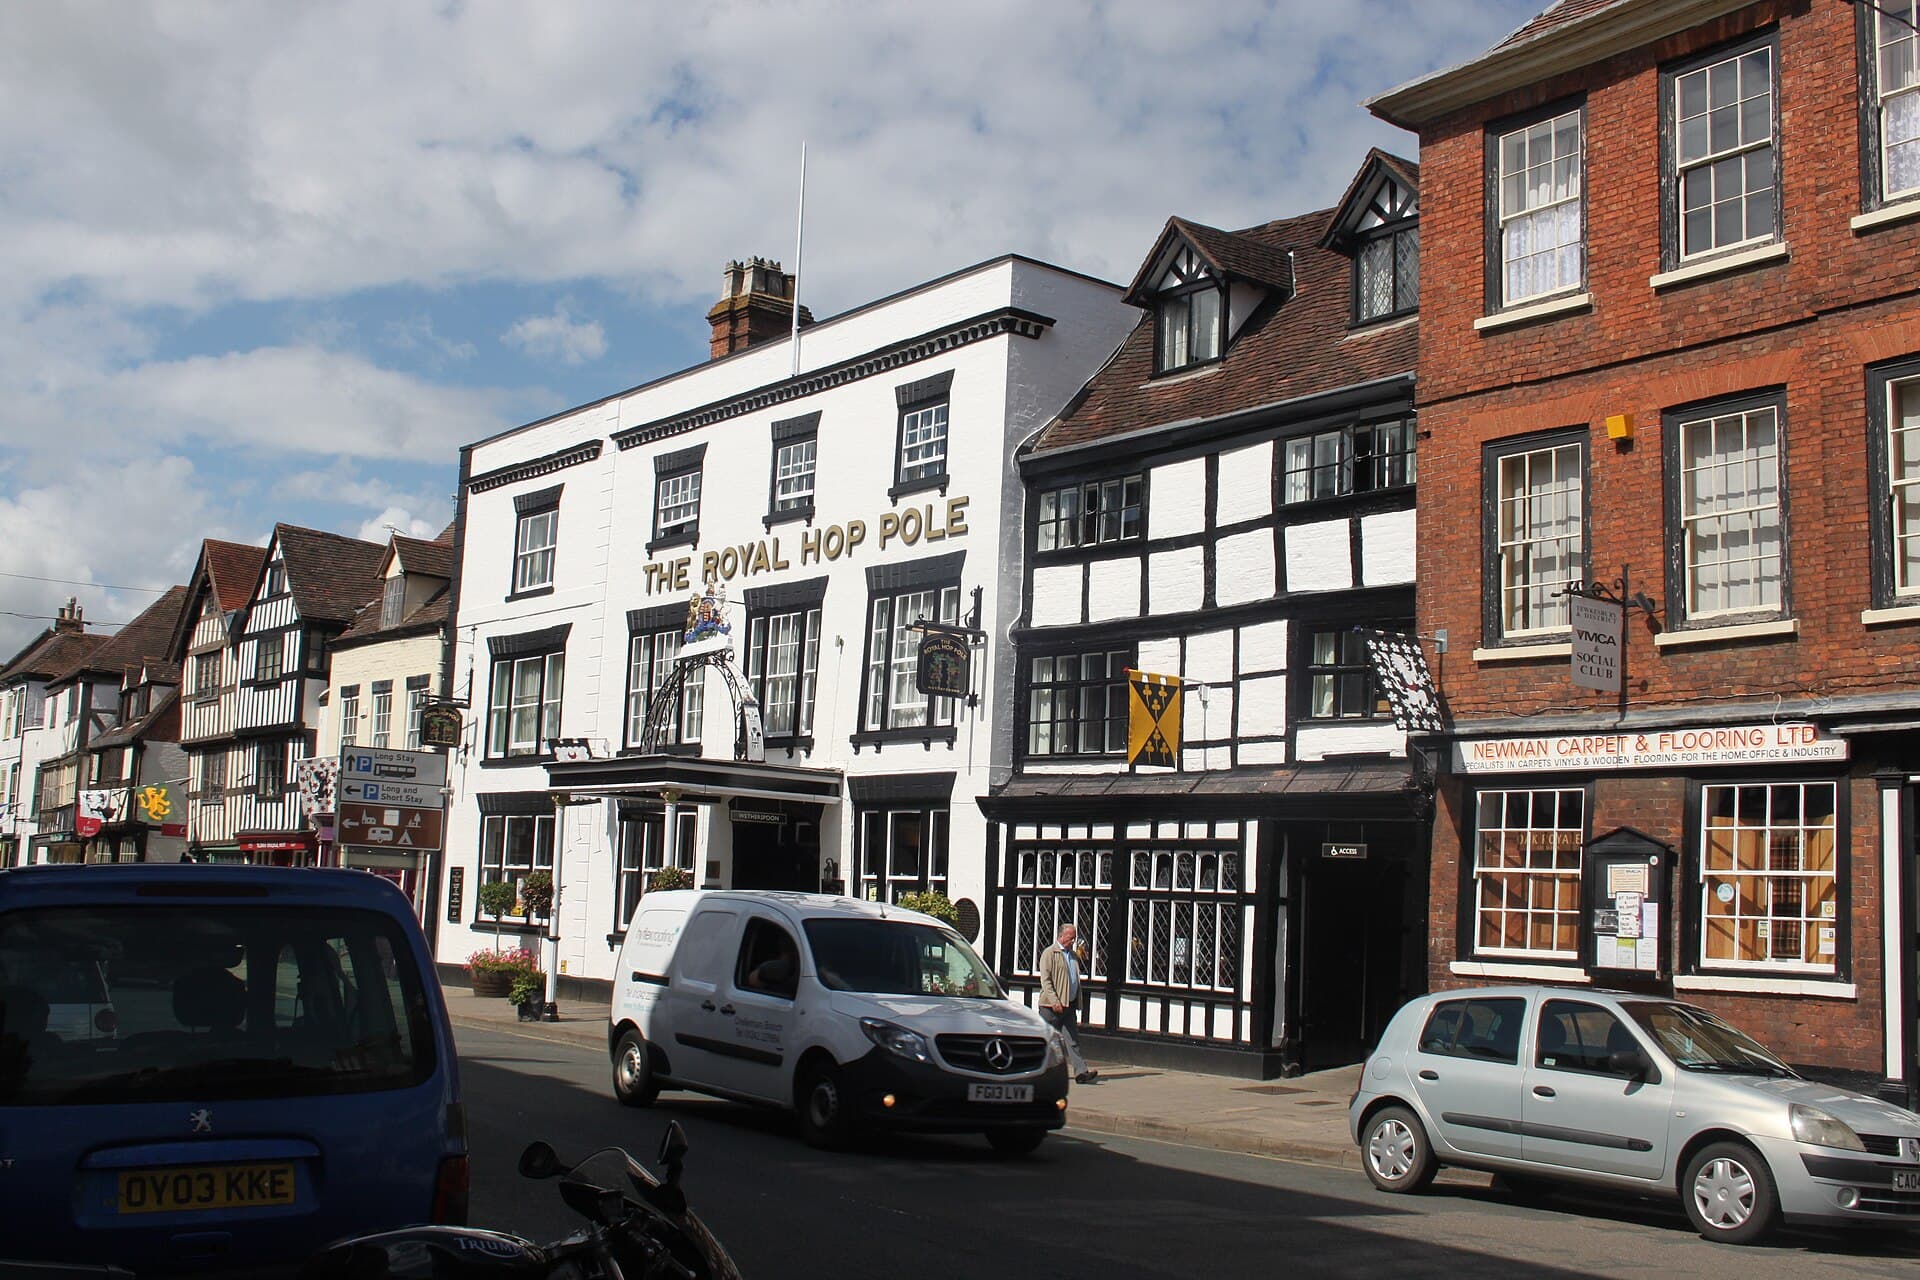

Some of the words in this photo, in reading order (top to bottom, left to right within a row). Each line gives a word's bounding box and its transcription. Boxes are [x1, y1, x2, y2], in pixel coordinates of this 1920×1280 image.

[642, 556, 691, 596] THE
[701, 537, 790, 583] ROYAL
[800, 519, 866, 566] HOP
[878, 496, 970, 550] POLE
[1576, 629, 1617, 646] YMCA
[1576, 651, 1616, 667] SOCIAL
[1580, 664, 1613, 679] CLUB
[1473, 739, 1549, 759] NEWMAN
[1556, 735, 1630, 756] CARPET
[1635, 735, 1649, 752] &
[1659, 728, 1764, 751] FLOORING
[1777, 726, 1818, 745] LTD
[374, 752, 394, 761] Long
[396, 753, 415, 763] Stay
[1462, 760, 1504, 770] SPECIALISTS
[1507, 760, 1515, 769] IN
[1554, 757, 1581, 767] VINYLS
[1583, 757, 1589, 765] &
[1592, 754, 1630, 765] WOODEN
[1634, 752, 1677, 764] FLOORING
[1682, 752, 1698, 762] FOR
[1702, 751, 1717, 761] THE
[1783, 748, 1789, 757] &
[1791, 746, 1837, 757] INDUSTRY
[381, 784, 401, 794] Long
[403, 786, 418, 794] and
[380, 793, 403, 802] Short
[405, 794, 424, 804] Stay
[975, 1085, 1003, 1099] FG13
[126, 1172, 215, 1207] OY03
[225, 1168, 289, 1201] KKE
